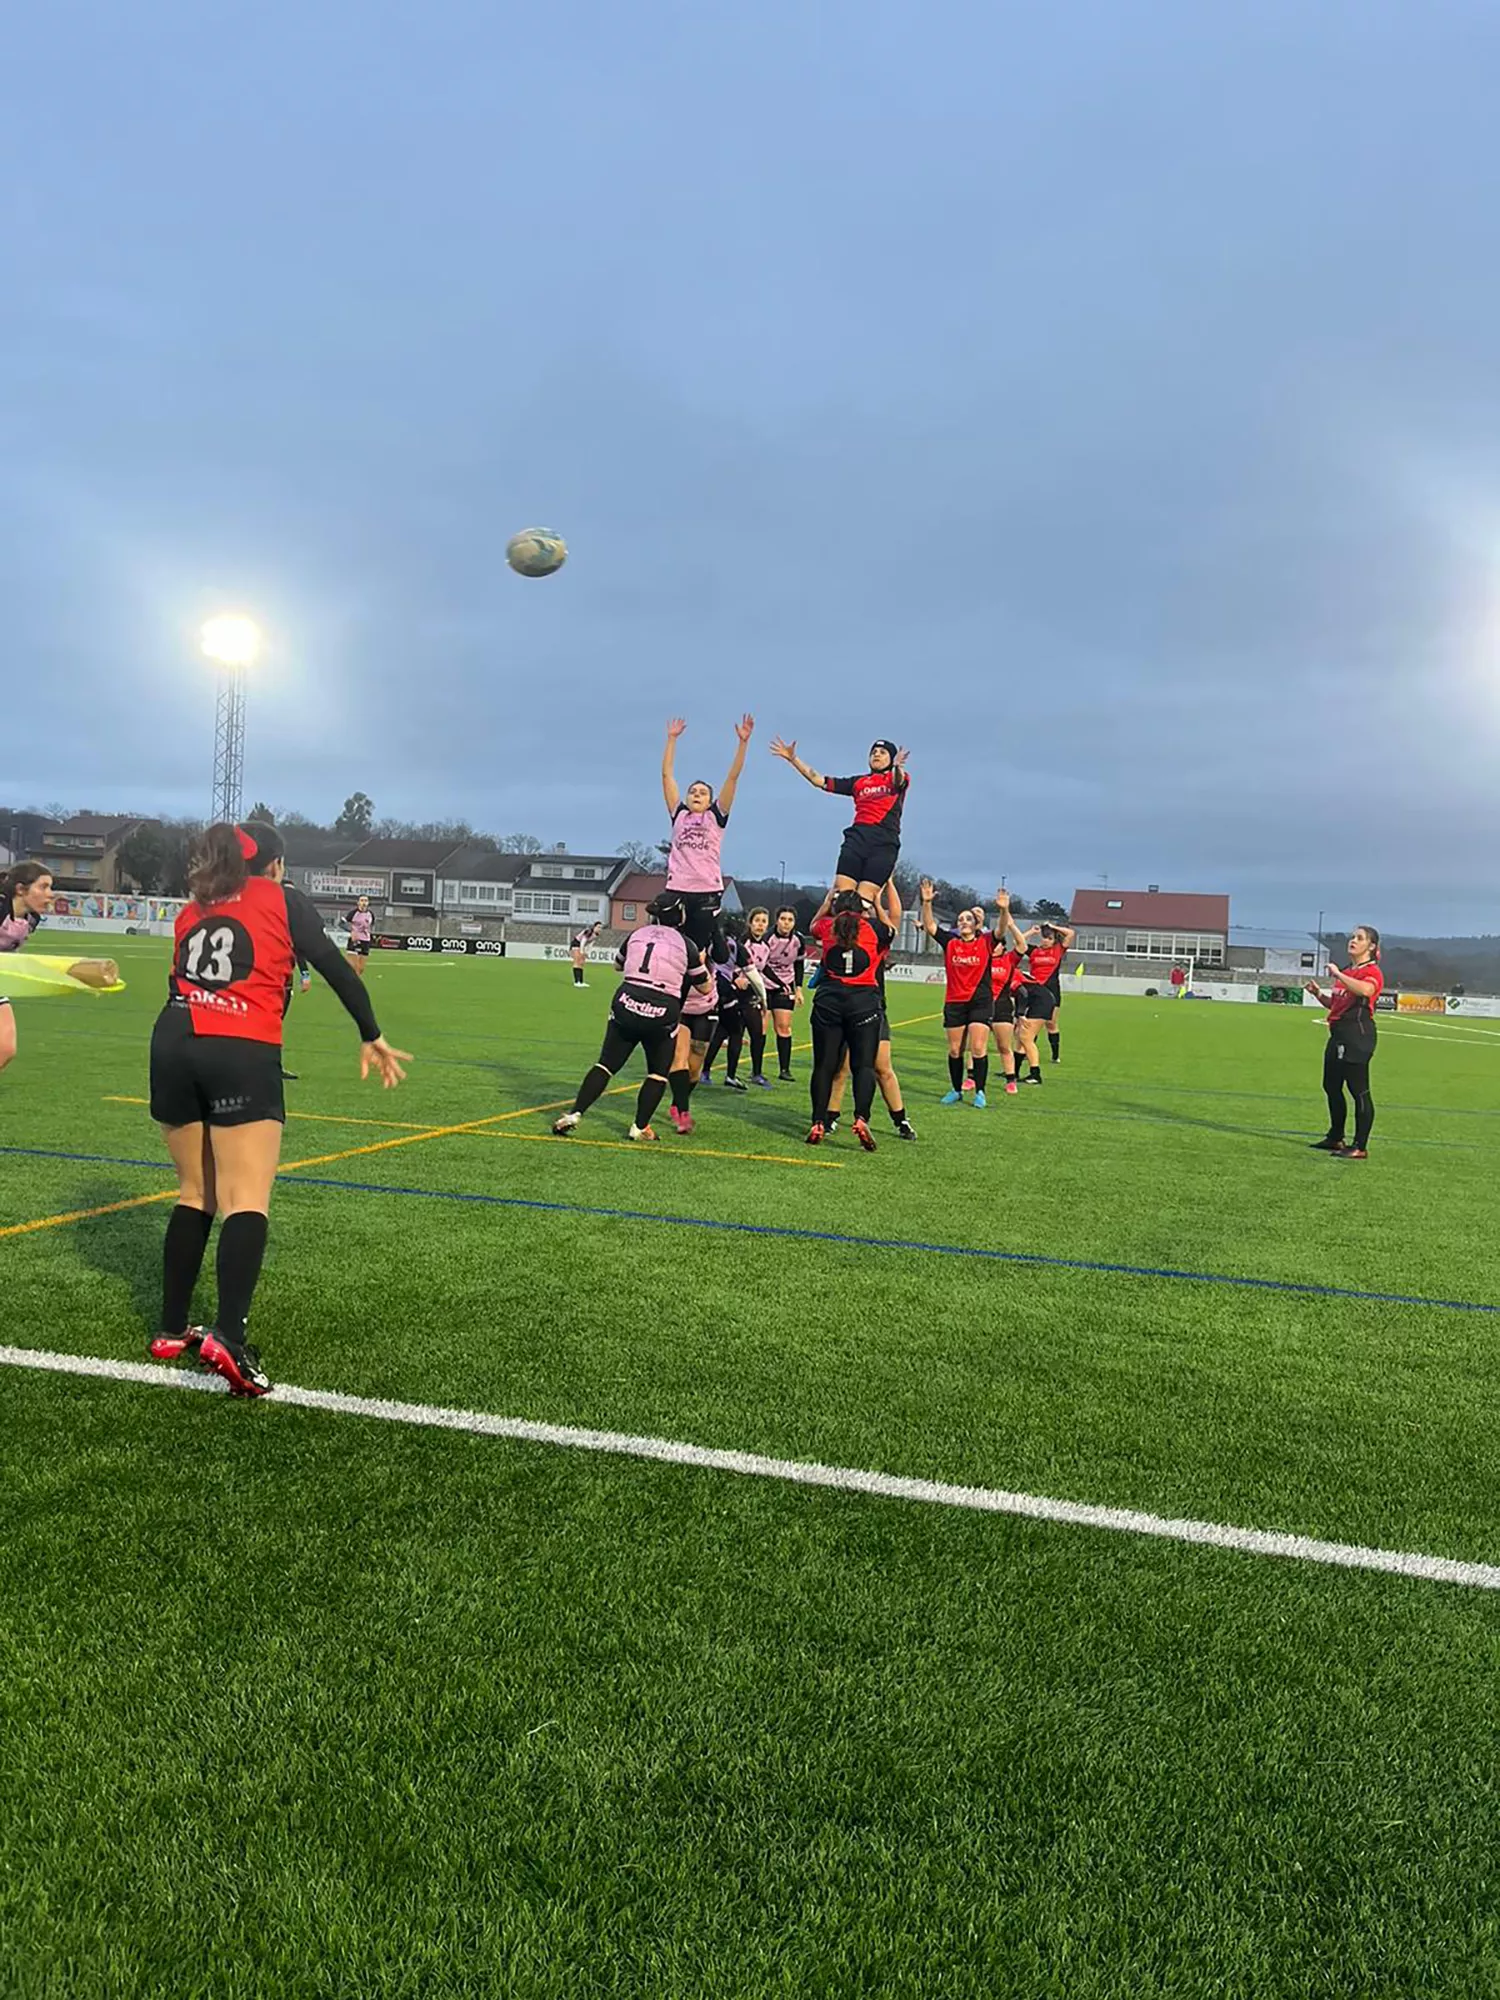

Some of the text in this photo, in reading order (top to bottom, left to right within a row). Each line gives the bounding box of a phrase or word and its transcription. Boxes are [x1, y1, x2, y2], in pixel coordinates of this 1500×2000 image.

[186, 926, 234, 981] 13
[407, 937, 433, 951] amg
[441, 939, 467, 953] amg
[475, 941, 501, 955] amg
[638, 942, 656, 974] 1
[841, 949, 854, 974] 1
